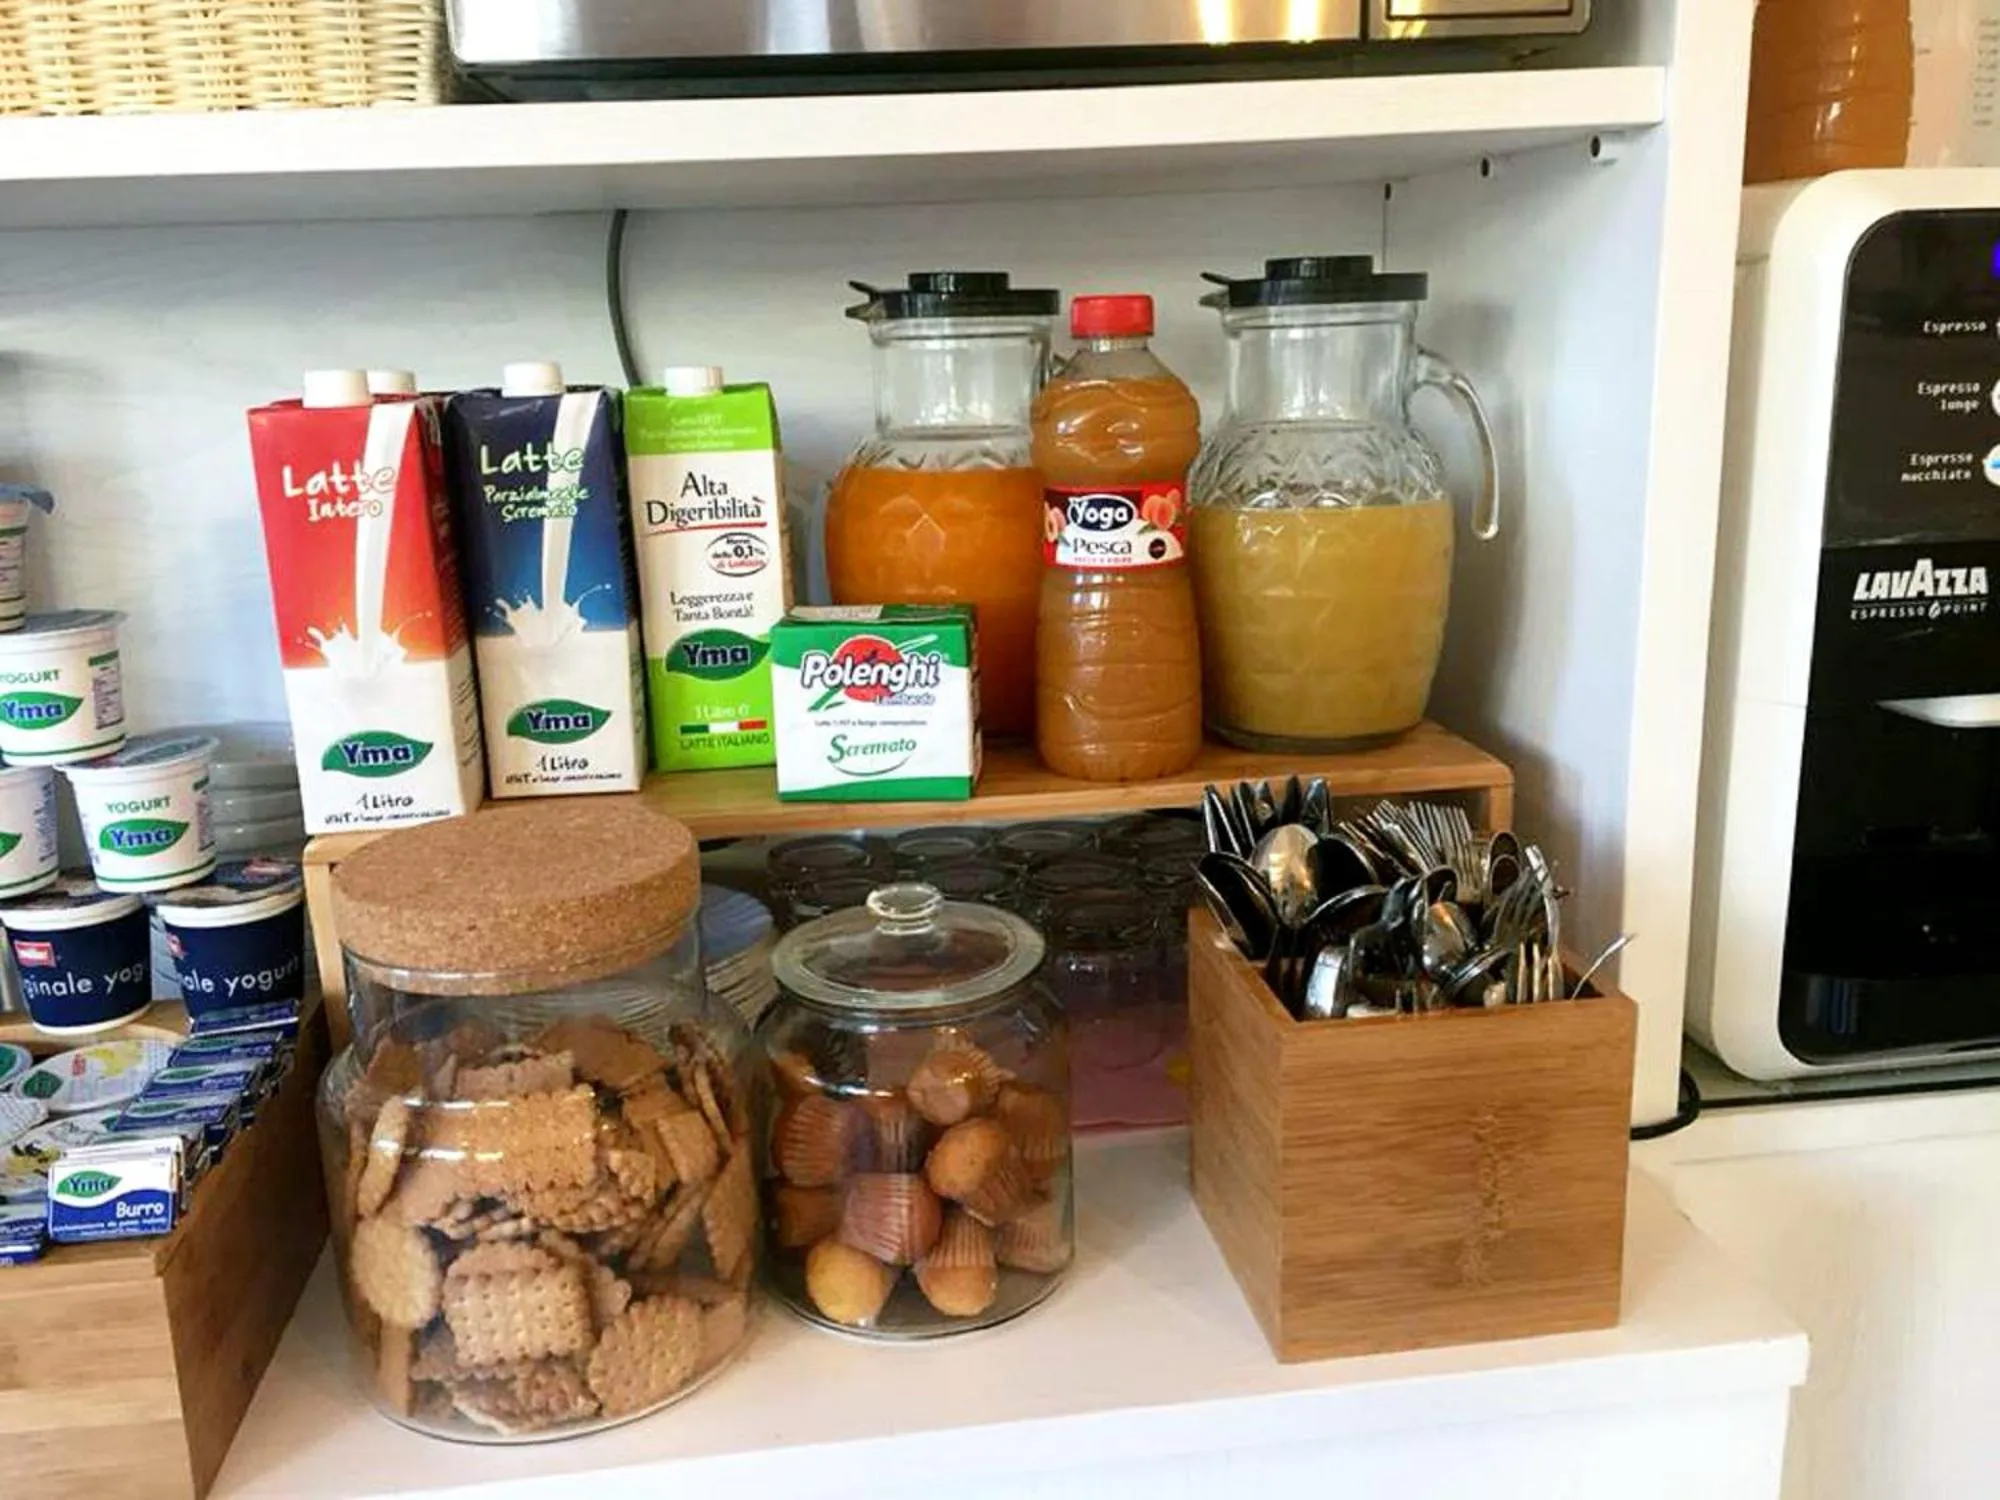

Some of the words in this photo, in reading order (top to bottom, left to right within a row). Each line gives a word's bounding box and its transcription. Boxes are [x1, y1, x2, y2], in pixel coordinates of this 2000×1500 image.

[1923, 320, 1987, 334] Espresso
[1917, 382, 1980, 396] Espresso
[481, 442, 584, 474] Latte
[1909, 453, 1973, 468] Espresso
[282, 458, 395, 498] Latte
[680, 471, 729, 498] Alta
[307, 496, 384, 521] Intero
[646, 497, 765, 529] Digeribilità
[1068, 497, 1129, 530] Yoga
[1073, 537, 1132, 555] Pesca
[1852, 558, 1989, 600] LAVAZZA
[1850, 605, 1926, 620] ESPRESSO
[682, 641, 750, 667] Yma
[801, 650, 942, 694] Polenghi
[2, 700, 63, 719] Yma
[526, 709, 592, 732] Yma
[341, 741, 412, 766] Yma
[826, 733, 917, 763] Scremato
[550, 757, 588, 771] Litro
[105, 796, 171, 813] YOGURT
[372, 794, 414, 809] Litro
[110, 828, 172, 847] Yma
[116, 1201, 164, 1218] Burro
